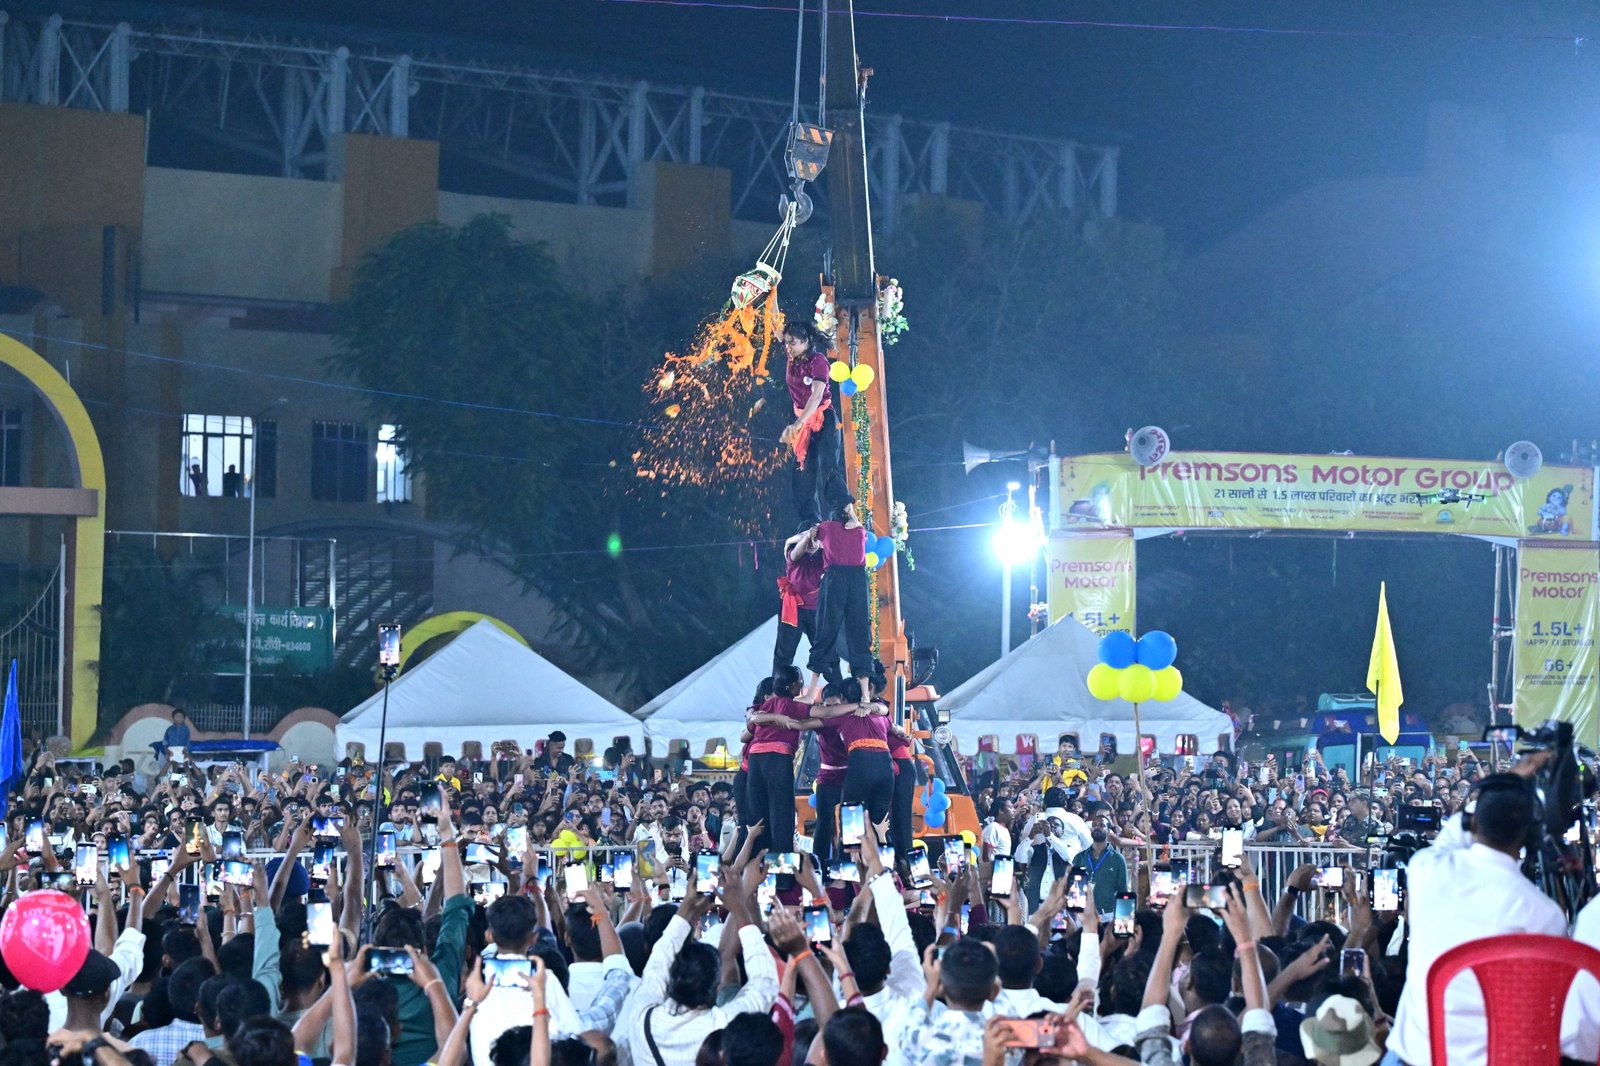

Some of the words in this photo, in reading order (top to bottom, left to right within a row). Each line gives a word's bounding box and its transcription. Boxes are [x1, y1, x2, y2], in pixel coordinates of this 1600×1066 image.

[1140, 461, 1298, 484] Premsons
[1312, 464, 1408, 487] Motor
[1415, 467, 1515, 497] Group
[1214, 489, 1225, 499] 21
[1228, 487, 1254, 500] सालों
[1257, 488, 1267, 500] से
[1273, 490, 1287, 500] 1.5
[1291, 491, 1316, 501] लाख
[1319, 488, 1356, 502] परिवारों
[1359, 492, 1373, 503] का
[1051, 559, 1133, 573] Premsons
[1065, 576, 1117, 589] Motor
[1520, 568, 1598, 585] Premsons
[1532, 586, 1584, 599] Motor
[1532, 620, 1584, 637] 1.5L+
